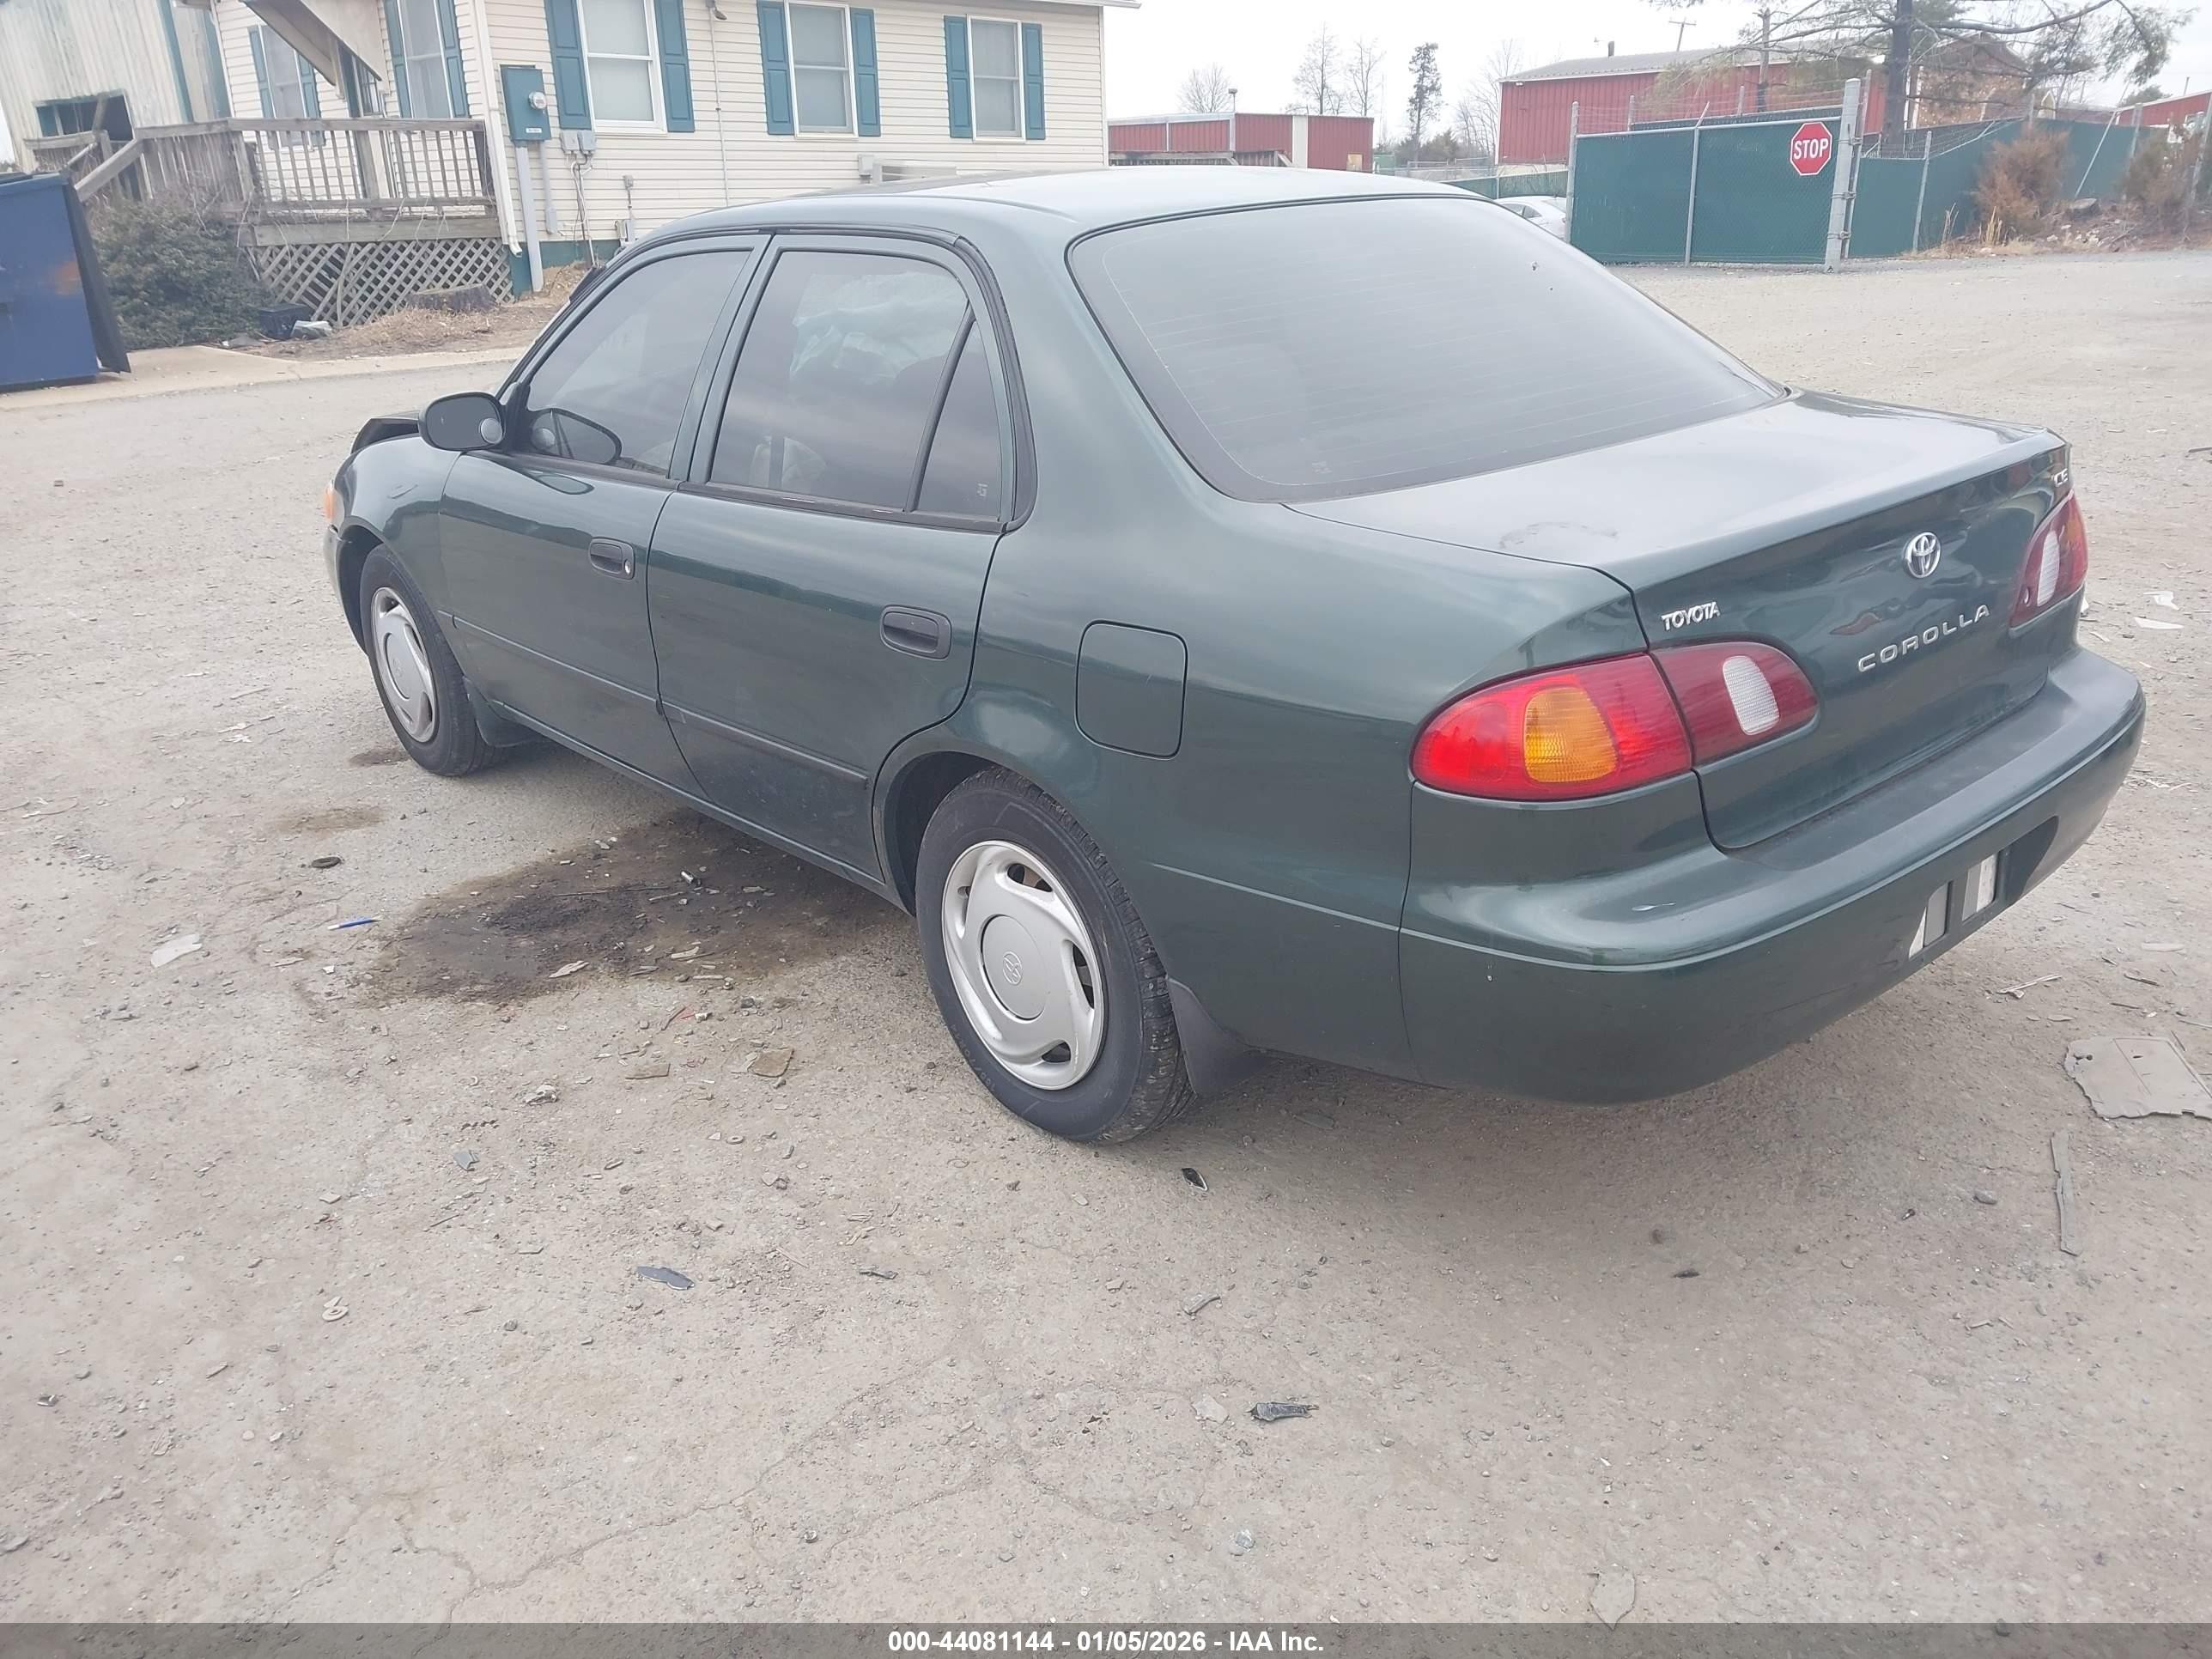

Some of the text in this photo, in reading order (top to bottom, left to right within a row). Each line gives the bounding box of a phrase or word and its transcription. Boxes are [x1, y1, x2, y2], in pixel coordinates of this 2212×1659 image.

[1794, 138, 1829, 160] STOP
[2053, 468, 2068, 487] CE
[1661, 601, 1721, 631] TOYOTA
[1858, 605, 1990, 672] COROLLA
